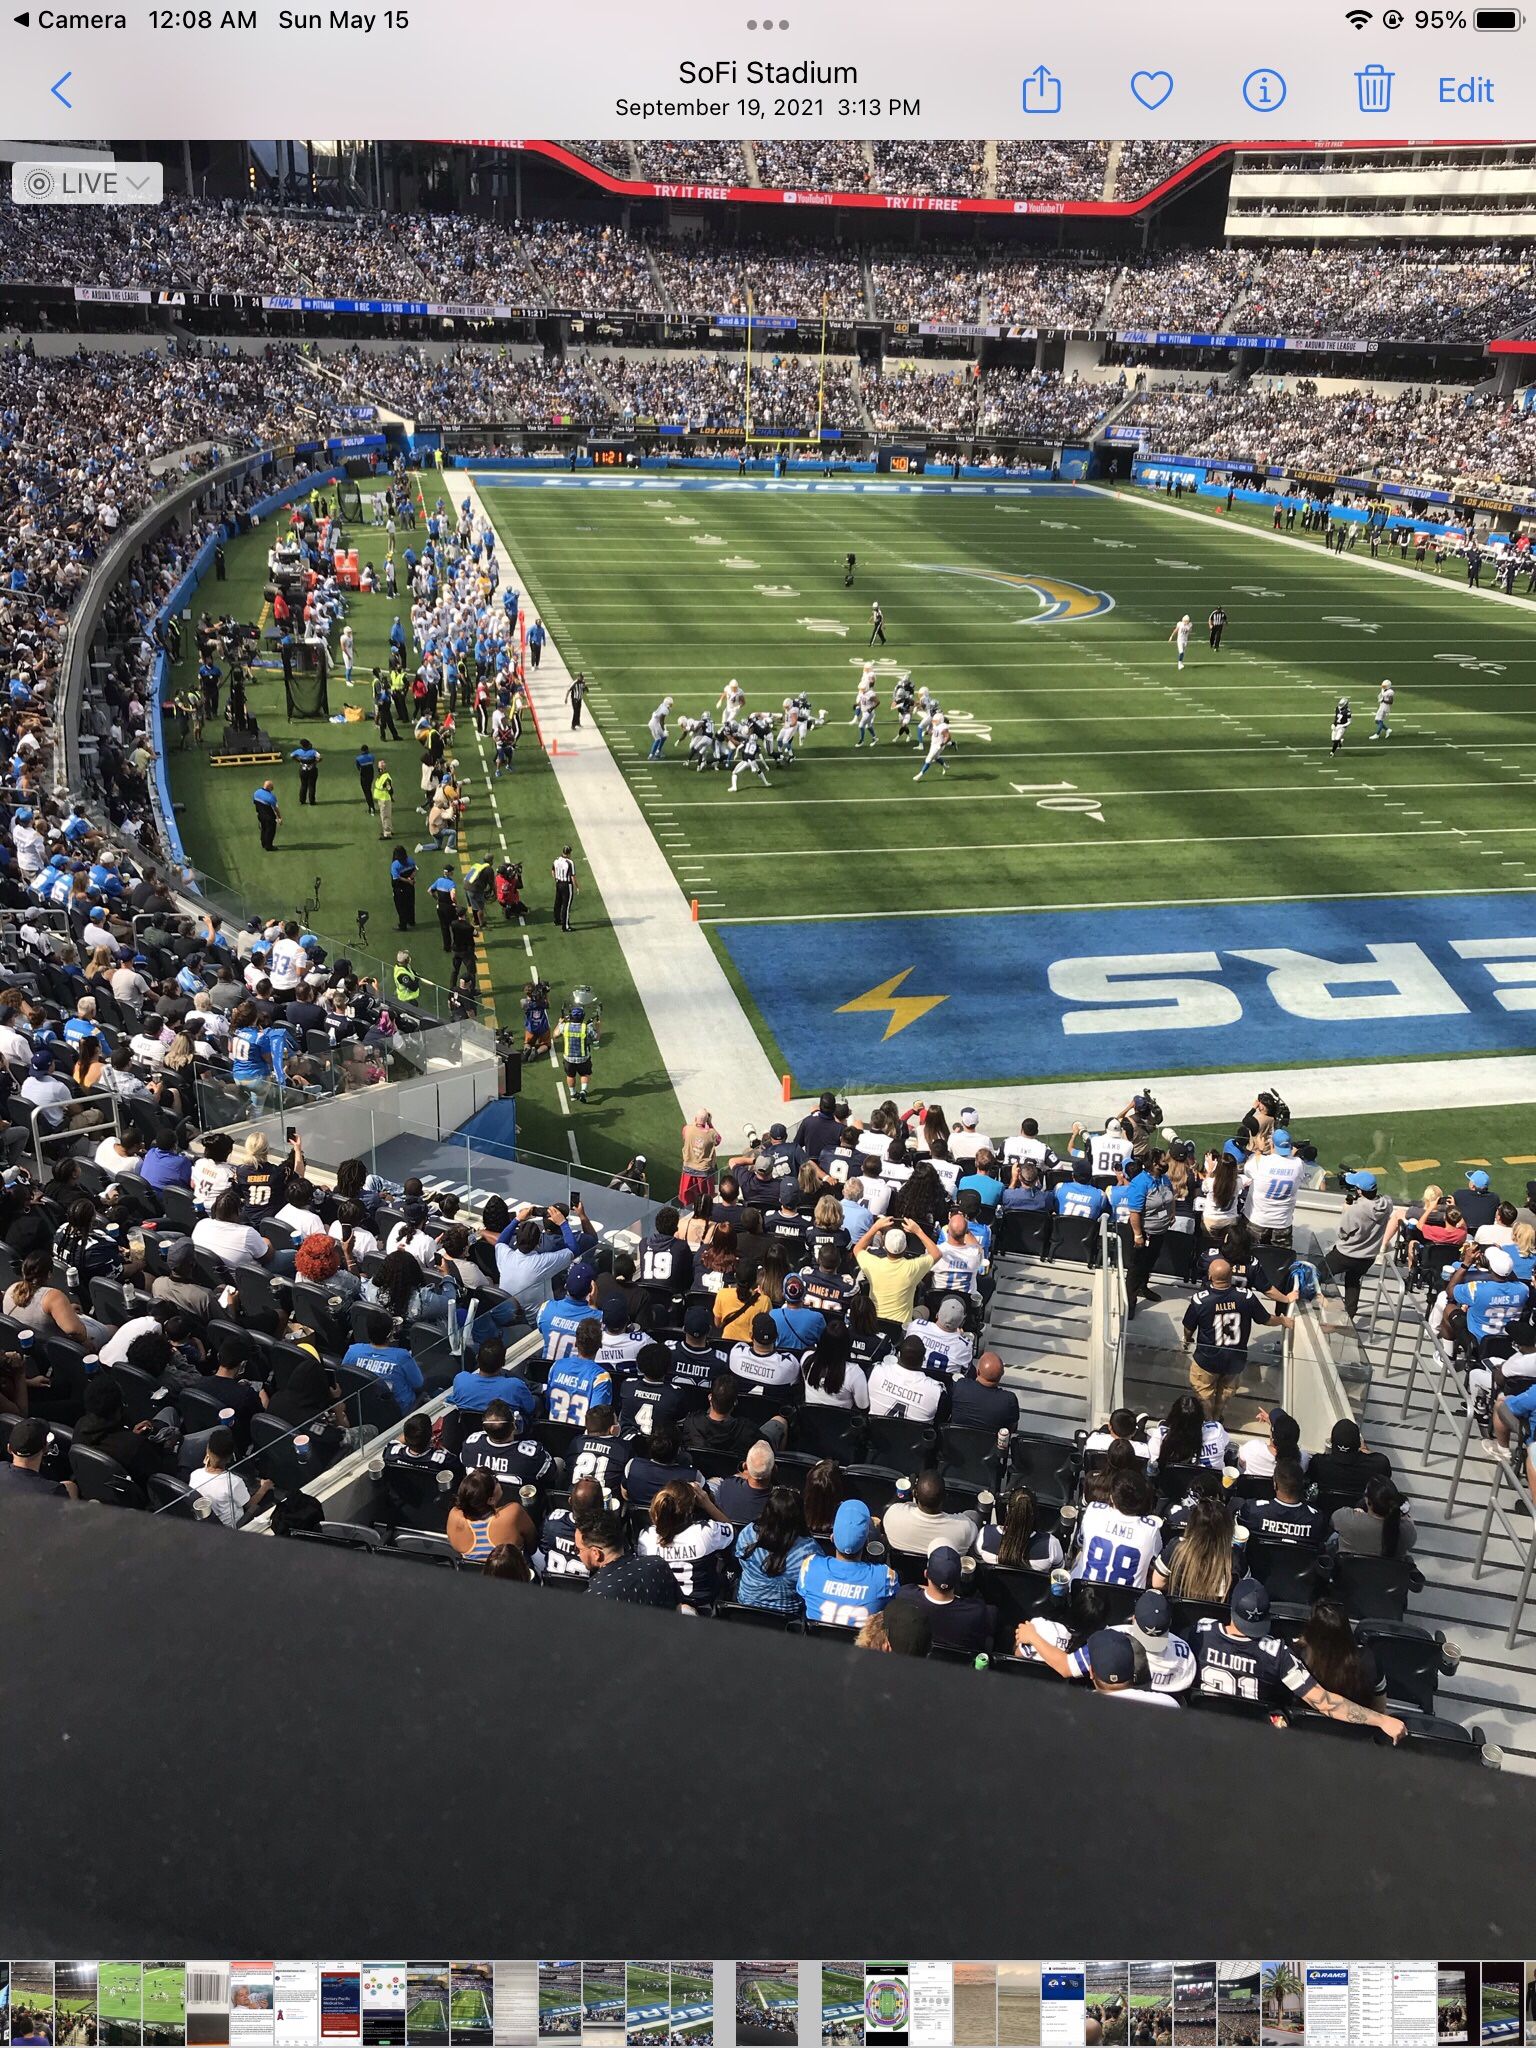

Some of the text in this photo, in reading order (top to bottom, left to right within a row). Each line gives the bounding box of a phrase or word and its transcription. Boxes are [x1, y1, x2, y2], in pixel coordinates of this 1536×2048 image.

[653, 184, 678, 198] TRY
[681, 185, 694, 198] IT
[884, 196, 909, 209] TRY
[913, 197, 926, 210] IT
[521, 308, 544, 317] 11:21
[663, 314, 672, 324] 14
[718, 317, 733, 325] 2nd
[740, 317, 746, 325] 2
[937, 325, 988, 336] AROUND THE LEAGUE
[1303, 340, 1356, 351] AROUND THE LEAGUE
[717, 427, 746, 436] ANGEL
[594, 450, 623, 464] 11:21
[890, 457, 908, 470] 40
[1293, 471, 1307, 479] LOS
[1306, 473, 1336, 484] ANGELES
[1462, 497, 1513, 512] LOS ANGELES
[1009, 780, 1106, 813] 10
[247, 1185, 272, 1206] 10
[1065, 1192, 1092, 1204] HERBERT
[1264, 1179, 1295, 1201] 10
[774, 1224, 801, 1237] AIKMAN
[643, 1250, 673, 1280] 19
[701, 1270, 725, 1294] 4
[806, 1282, 841, 1299] JAMES JR
[1214, 1301, 1237, 1312] ALLEN
[1488, 1294, 1520, 1306] JAMES JR
[551, 1316, 580, 1332] HERBER
[1211, 1312, 1242, 1347] 13
[851, 1340, 866, 1351] AMB
[921, 1335, 951, 1356] COOPER
[600, 1349, 625, 1361] IRVIN
[356, 1357, 398, 1376] HERBERT
[675, 1361, 711, 1378] ELLIOTT
[740, 1361, 776, 1380] PRESCOTT
[553, 1372, 590, 1392] JAMES JR
[634, 1389, 662, 1402] PRESCOTT
[881, 1378, 924, 1404] PRESCOTT
[548, 1387, 590, 1427] 33
[634, 1402, 654, 1435] 4
[582, 1440, 612, 1456] ELLIOTT
[476, 1452, 509, 1474] LAMB
[571, 1451, 610, 1489] 21
[1104, 1519, 1134, 1540] LAMB
[1261, 1517, 1312, 1538] PRESCOTT
[655, 1544, 698, 1561] AIKMAN
[1083, 1535, 1142, 1587] 88
[822, 1579, 869, 1601] HERBERT
[818, 1600, 869, 1629] 10
[1206, 1648, 1258, 1675] ELLIOTT
[1199, 1664, 1259, 1701] 21
[1320, 1972, 1347, 1980] RAMS
